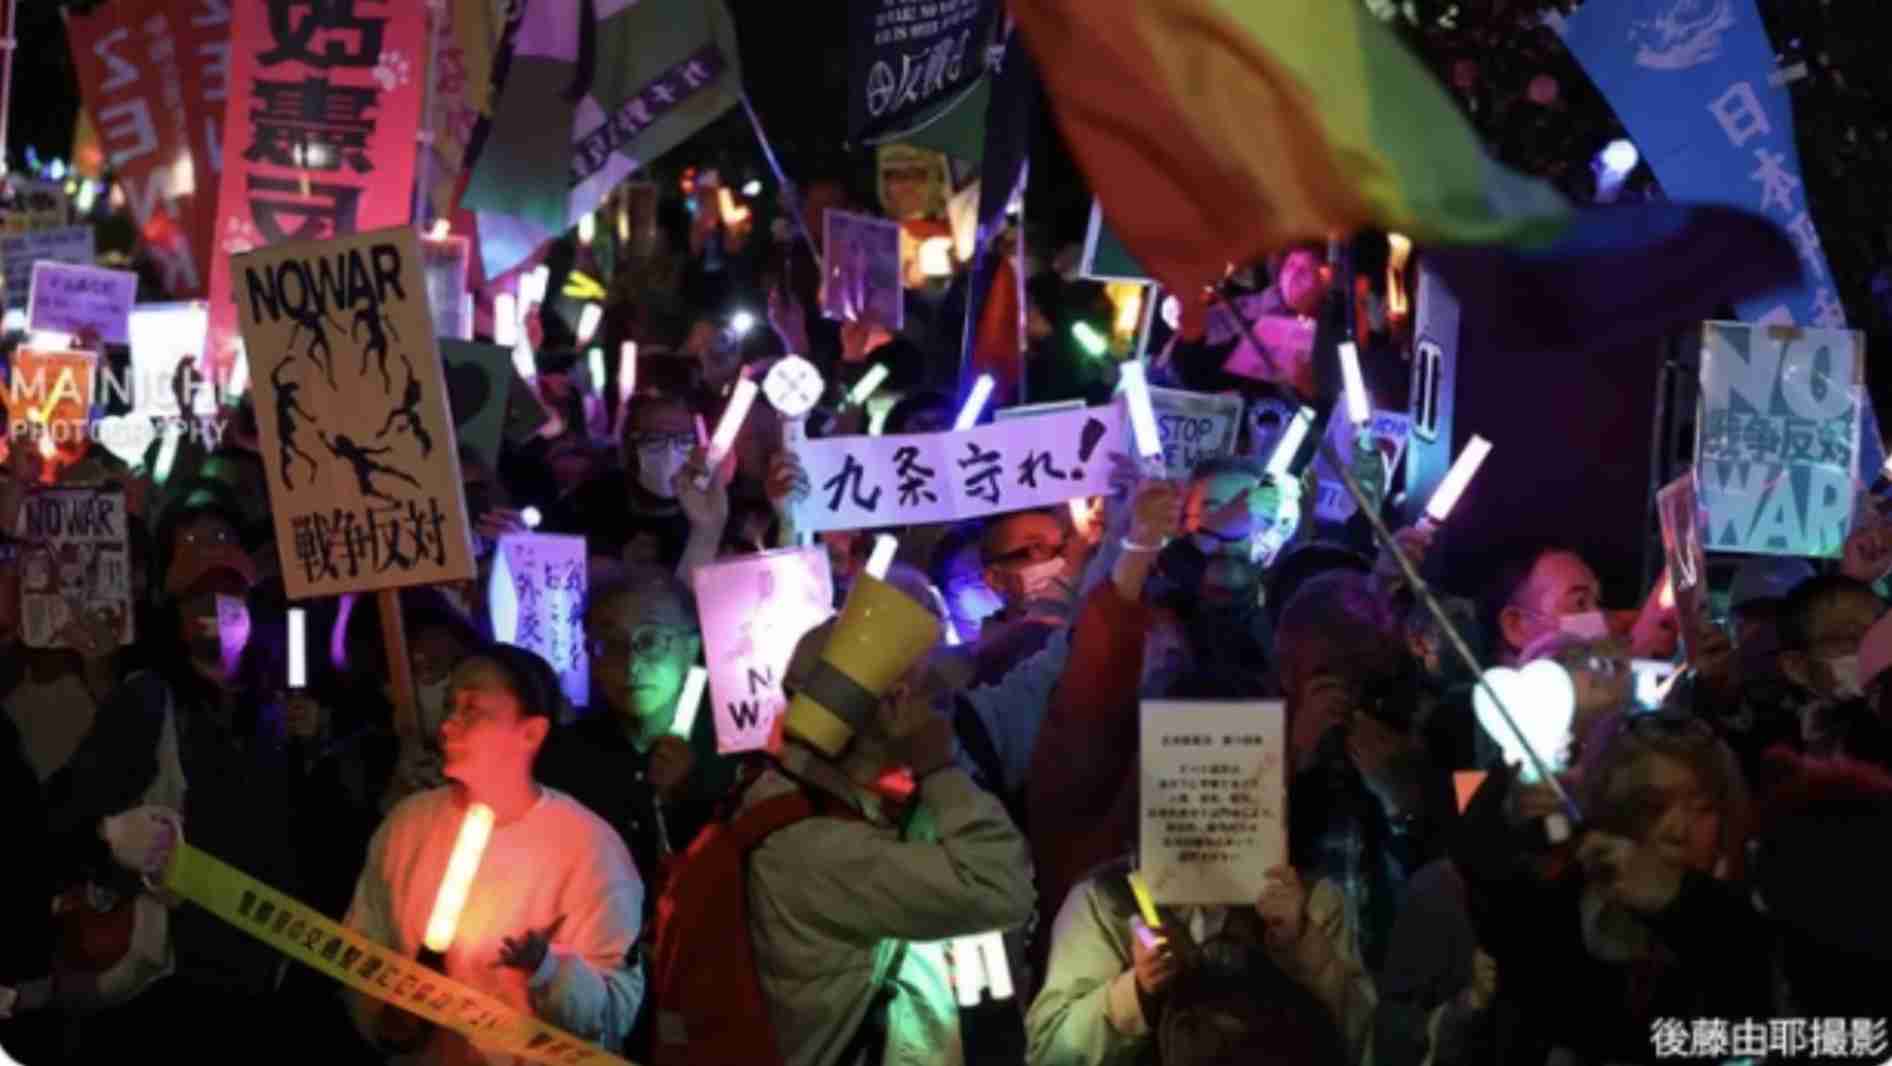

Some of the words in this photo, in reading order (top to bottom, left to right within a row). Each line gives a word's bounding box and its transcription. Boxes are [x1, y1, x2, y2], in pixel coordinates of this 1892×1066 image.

[1700, 325, 1855, 420] NO
[1158, 415, 1214, 443] STOP
[25, 498, 63, 535] NO
[64, 497, 115, 536] WAR
[288, 497, 446, 584] 戦争反対
[1700, 460, 1852, 553] WAR
